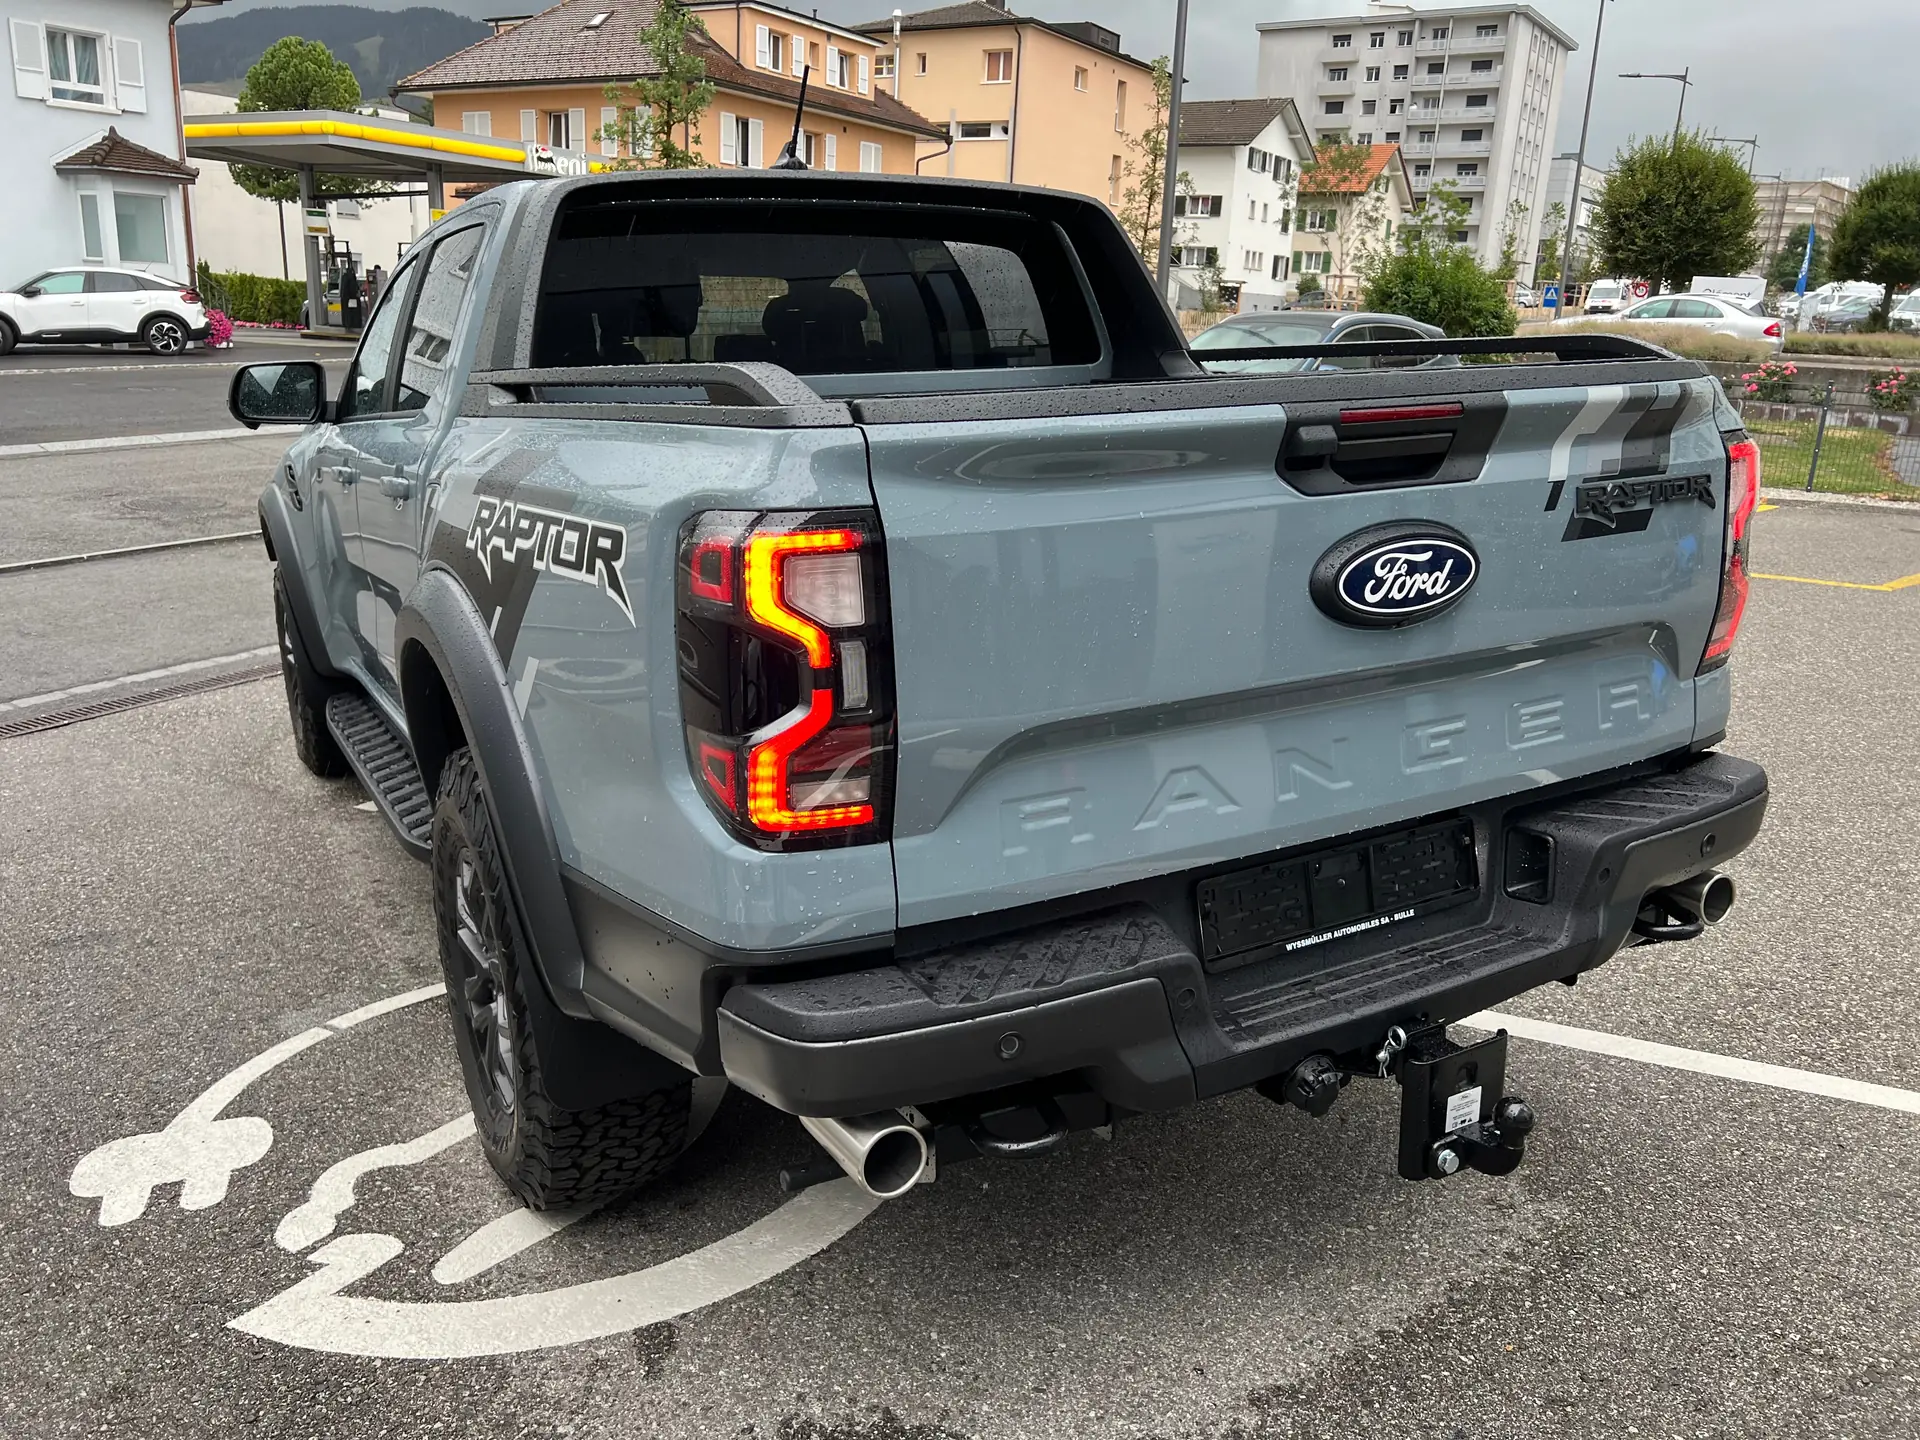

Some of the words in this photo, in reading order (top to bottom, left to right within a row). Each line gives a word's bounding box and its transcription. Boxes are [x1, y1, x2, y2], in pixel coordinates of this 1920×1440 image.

[556, 153, 587, 176] eni
[1575, 474, 1716, 528] RAPTOR
[465, 494, 636, 629] RAPTOR
[1364, 550, 1454, 604] Ford
[999, 679, 1652, 858] RANGER
[1285, 931, 1333, 952] WYSSMÜLLER
[1333, 918, 1380, 939] AUTOMOBILES
[1380, 915, 1390, 925] SA
[1393, 908, 1415, 921] BULLE
